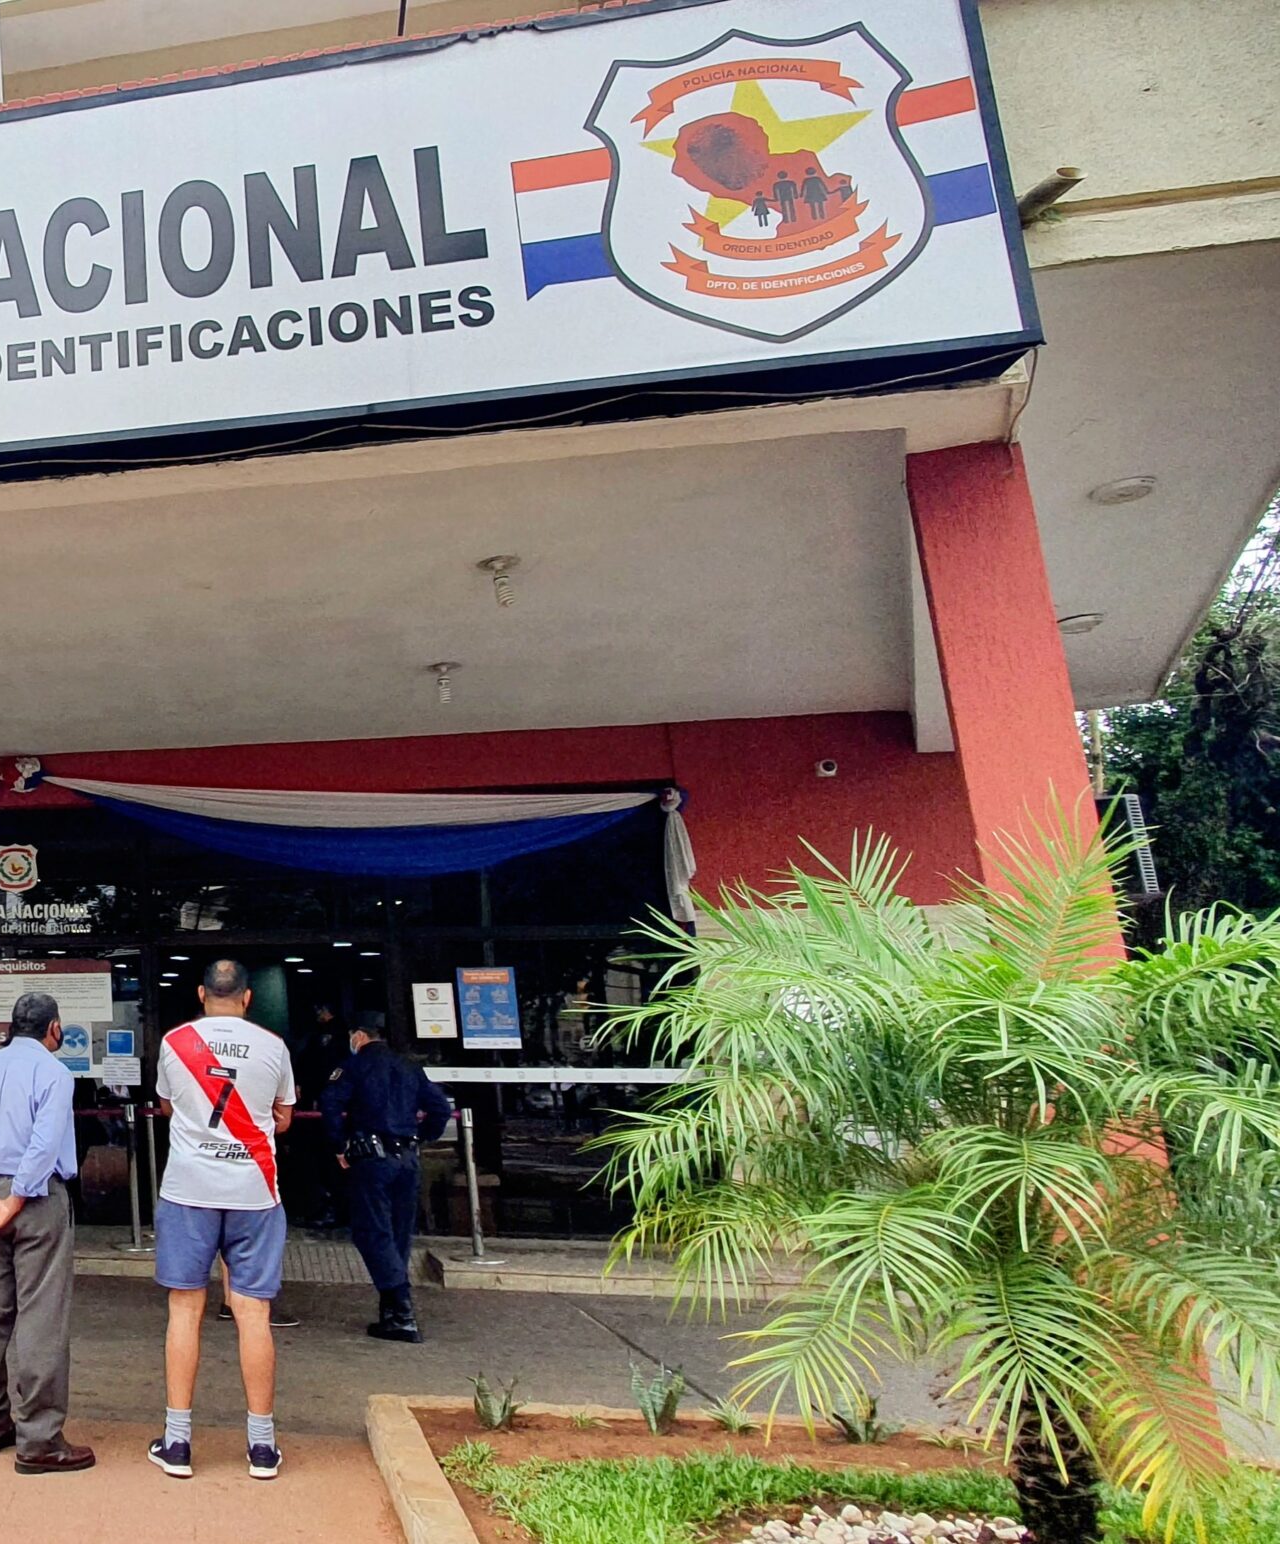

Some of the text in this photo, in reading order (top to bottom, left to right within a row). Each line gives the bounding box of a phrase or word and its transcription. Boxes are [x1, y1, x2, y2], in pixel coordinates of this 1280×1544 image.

[737, 63, 808, 76] NACIONAL
[722, 231, 834, 253] ORDEN E IDENTIDAD
[706, 262, 865, 290] DPTO. DE IDENTIFICACIONES
[10, 903, 92, 919] NACIONAL
[208, 1040, 250, 1059] SUAREZ
[206, 1066, 237, 1129] 7
[198, 1142, 253, 1152] ASSIST
[215, 1151, 254, 1160] CARD
